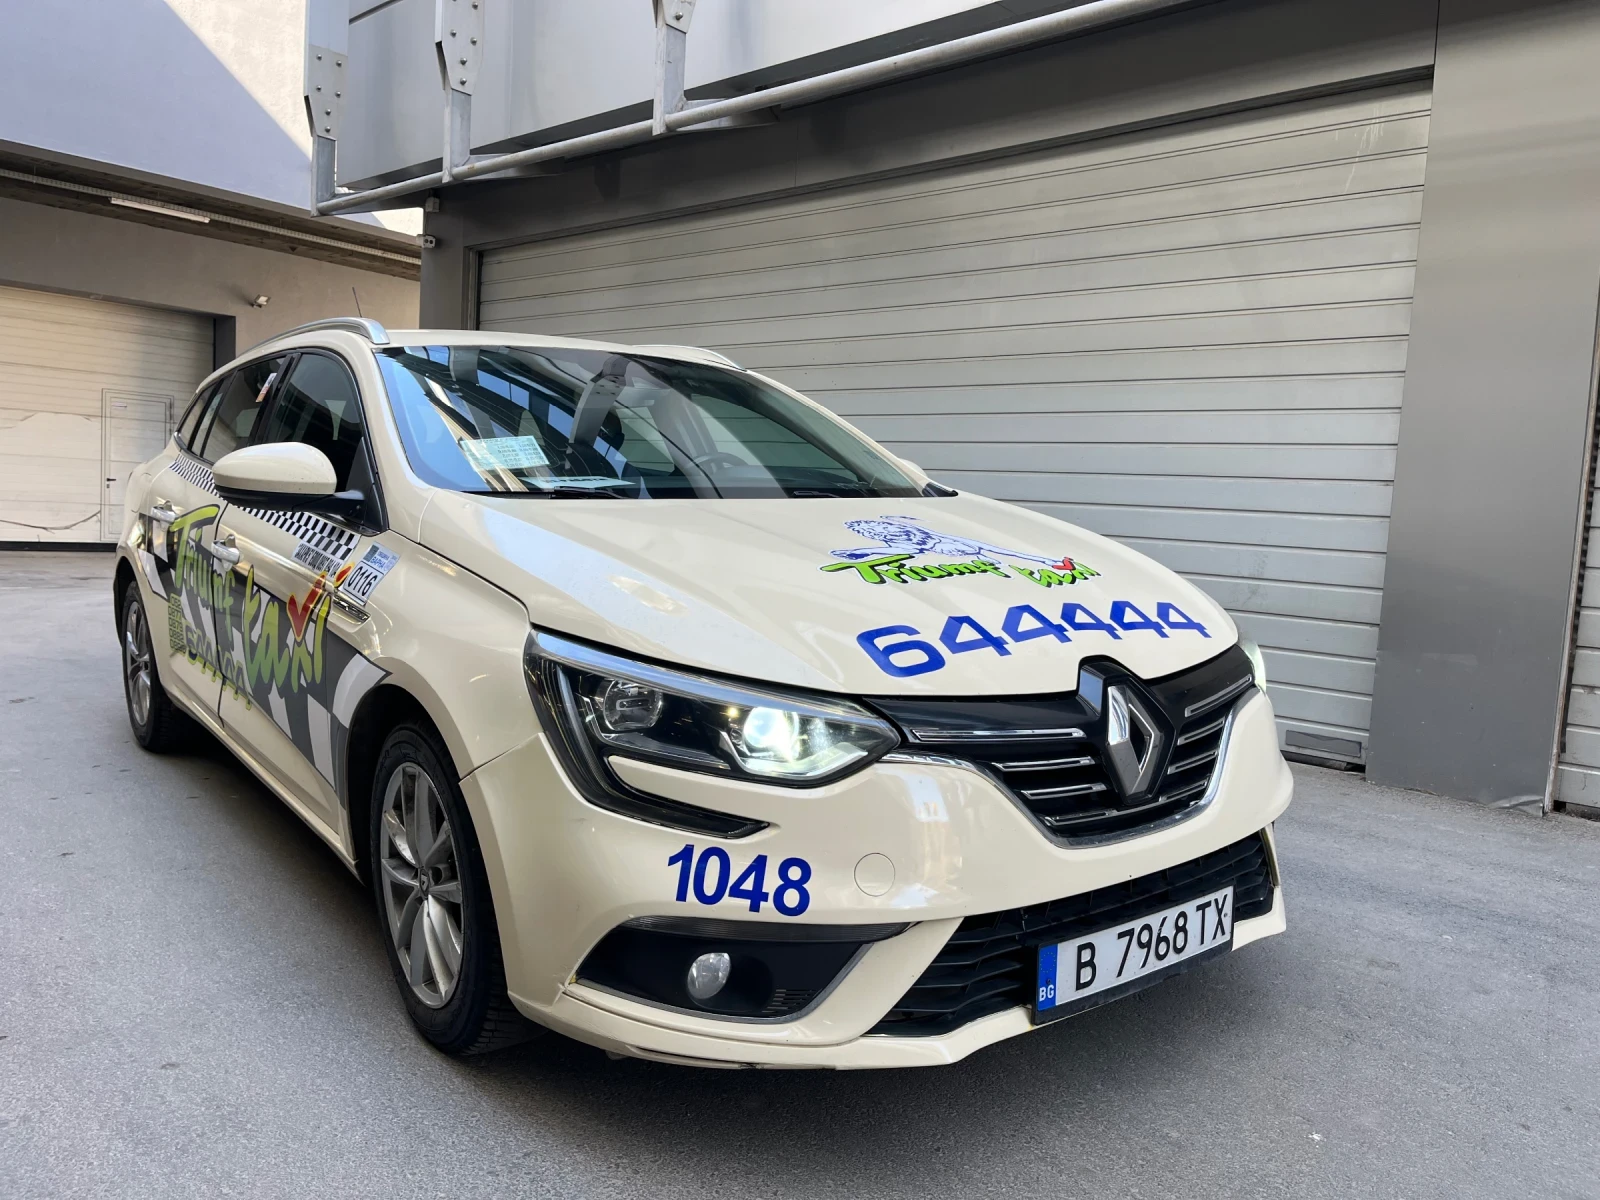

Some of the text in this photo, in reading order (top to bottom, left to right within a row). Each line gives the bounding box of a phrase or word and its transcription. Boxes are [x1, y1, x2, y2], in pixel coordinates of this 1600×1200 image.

[170, 504, 332, 693] Triumf taxi
[347, 566, 378, 597] 0116
[821, 554, 1101, 588] Triumf taxi
[857, 600, 1212, 678] 644444
[667, 844, 812, 917] 1048
[1075, 894, 1229, 992] B 7968 TX
[1039, 985, 1055, 1002] BG
